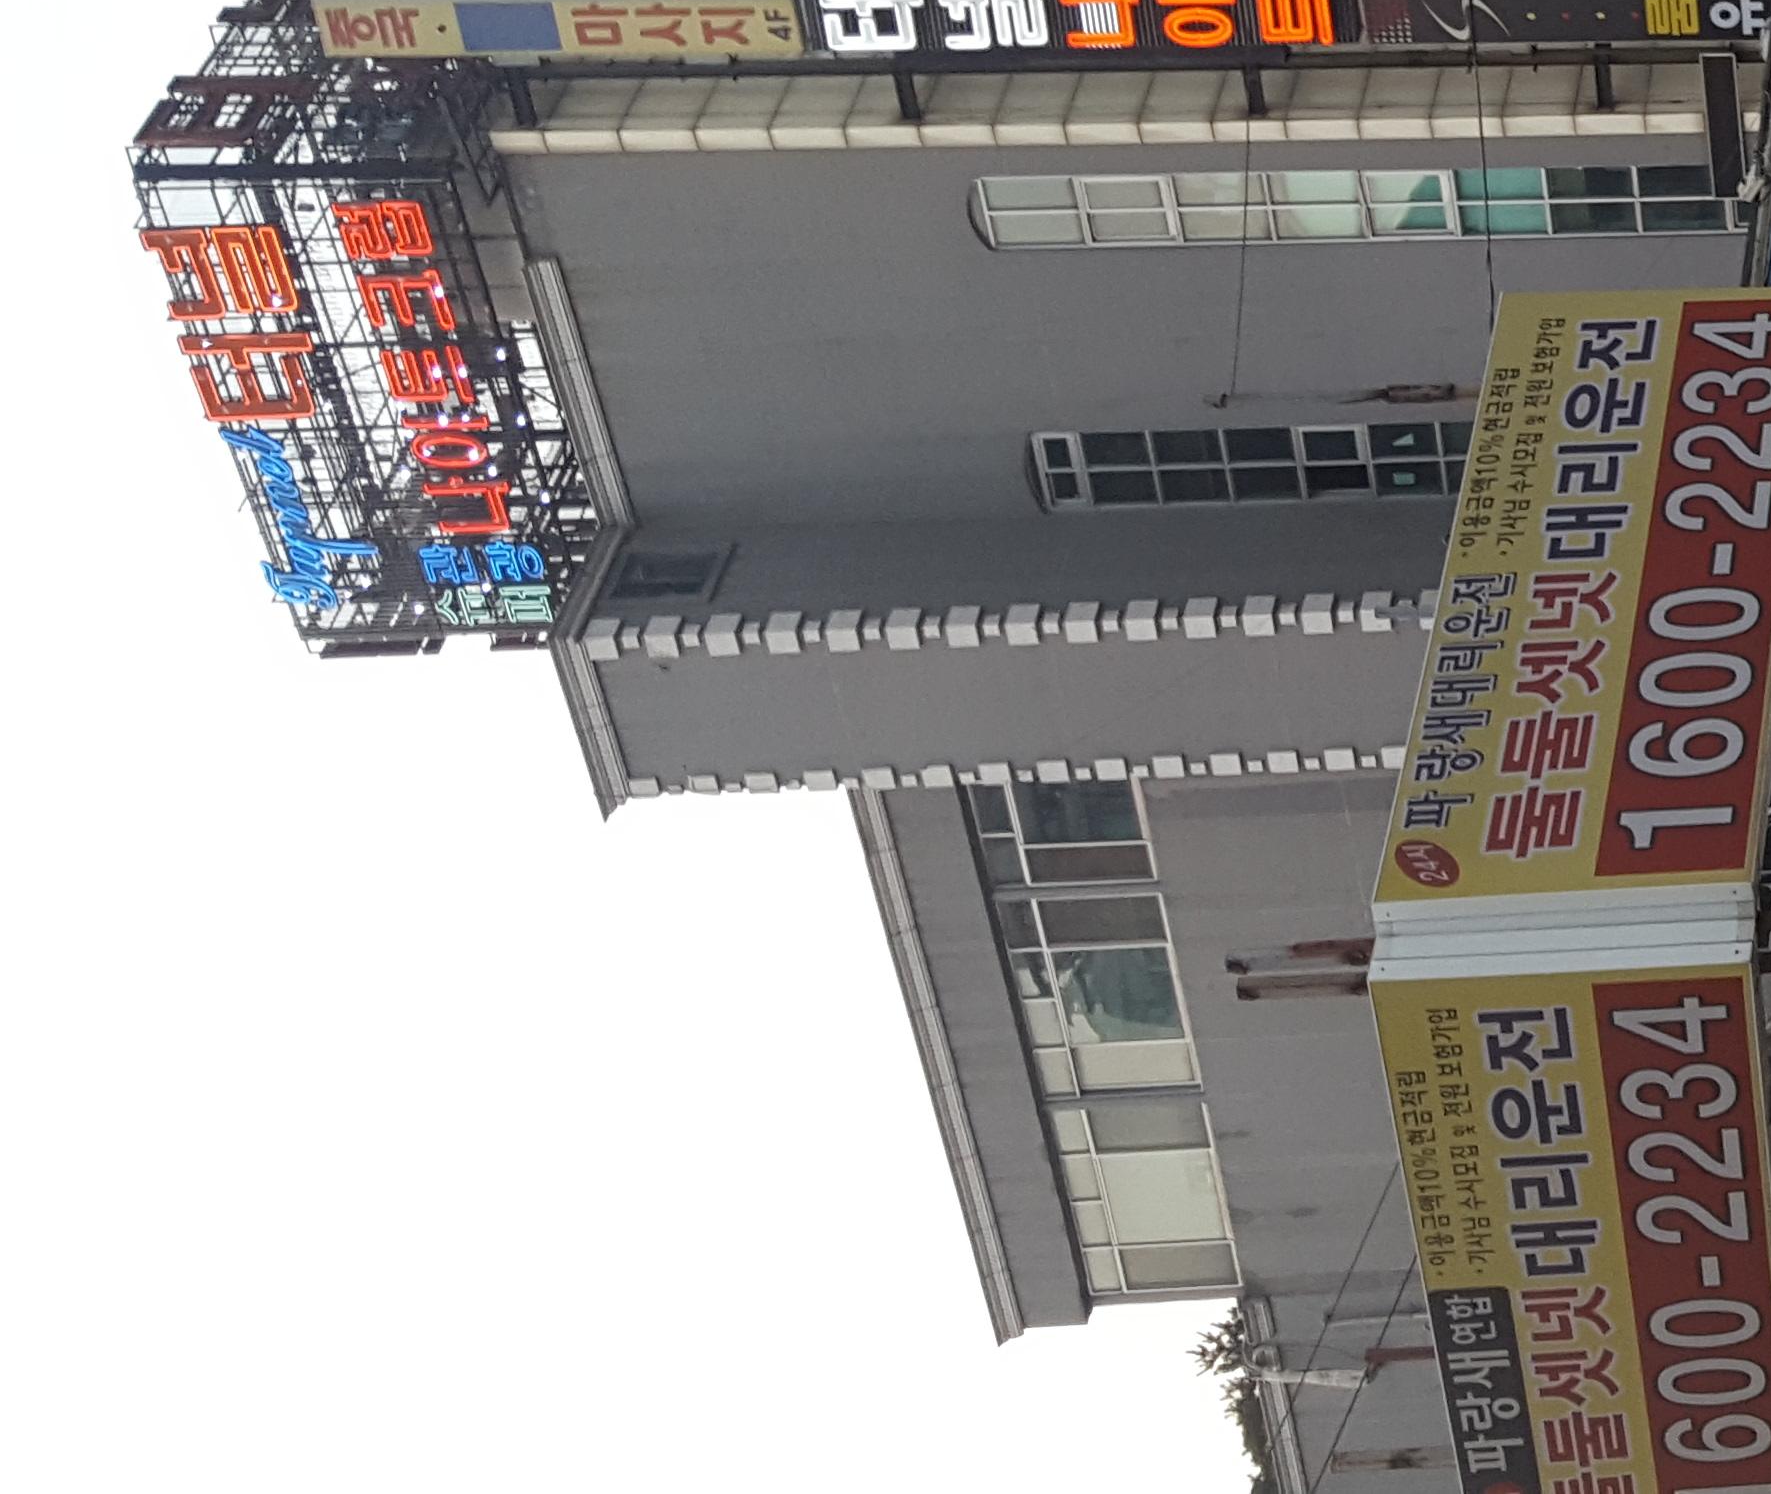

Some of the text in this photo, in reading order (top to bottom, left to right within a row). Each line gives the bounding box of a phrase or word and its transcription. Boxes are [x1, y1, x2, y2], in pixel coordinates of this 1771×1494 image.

[325, 6, 420, 47] 중국
[570, 3, 756, 47] 마사지
[763, 8, 793, 42] 4F
[138, 224, 316, 424] 터널
[1530, 318, 1566, 374] 보험가입
[330, 201, 512, 534] 나이트크럽
[1523, 379, 1554, 408] 전원
[1506, 432, 1543, 493] 수시모집
[1496, 498, 1532, 547] 기사님
[1485, 317, 1656, 859] 둘둘셋넷 대리운전
[1425, 1007, 1463, 1078] 보험가입
[1440, 1083, 1473, 1118] 전원
[1476, 1005, 1600, 1278] 대리운전
[1449, 1144, 1485, 1210] 수시모집
[1463, 1216, 1495, 1265] 기사님
[1443, 1292, 1526, 1474] 파랑새 연합
